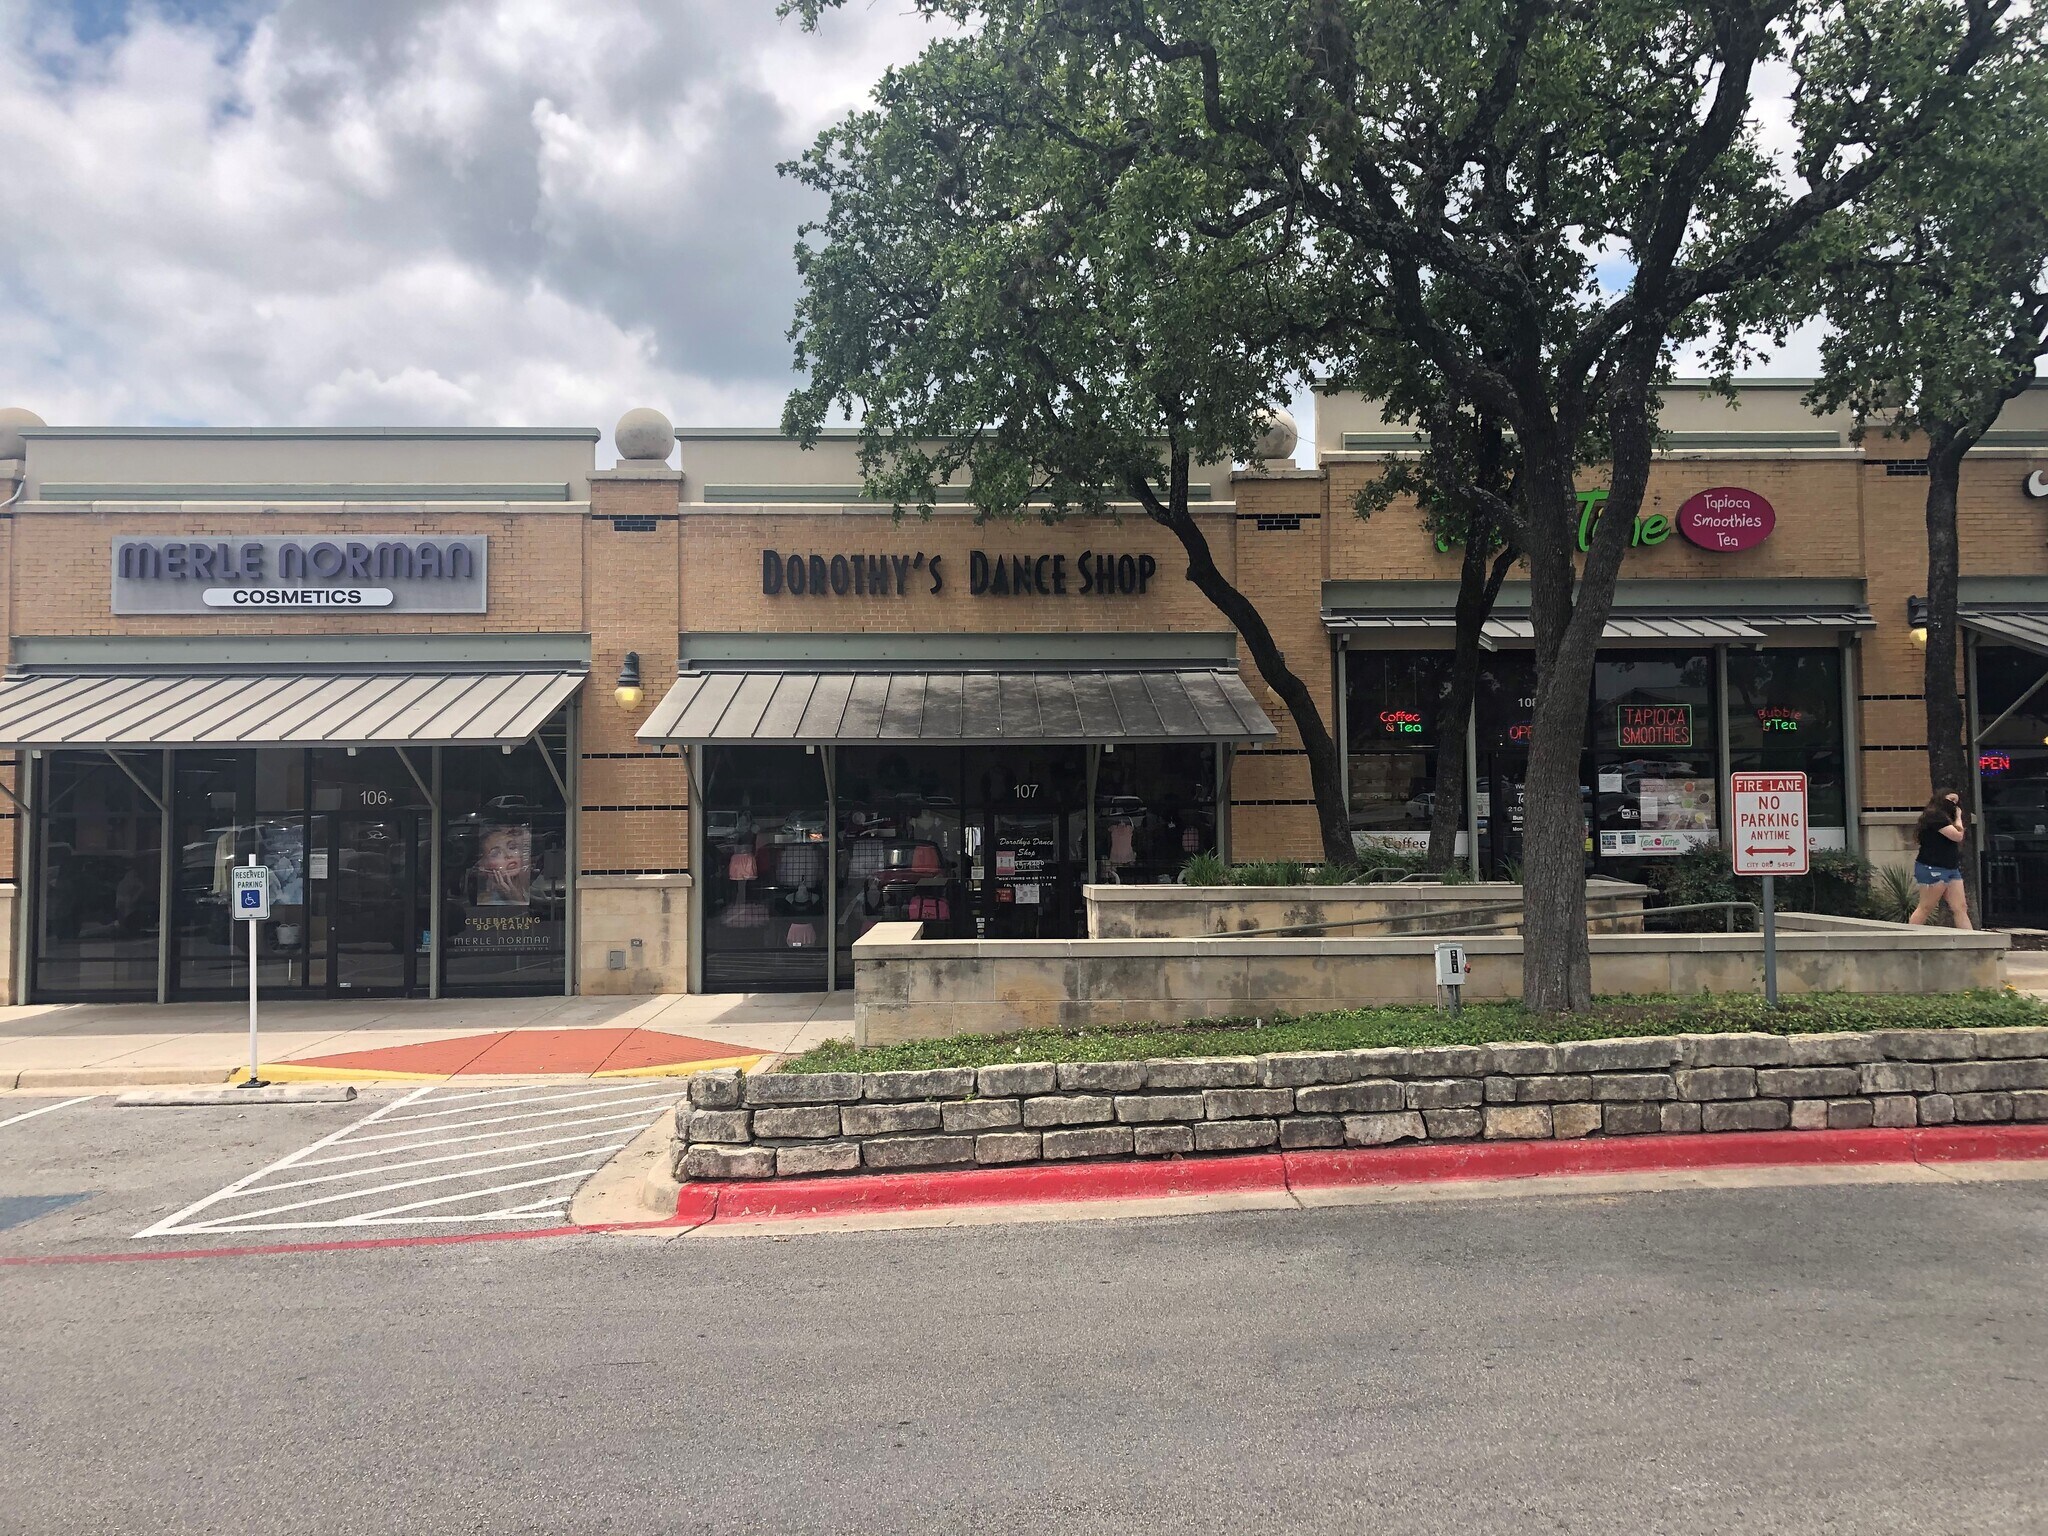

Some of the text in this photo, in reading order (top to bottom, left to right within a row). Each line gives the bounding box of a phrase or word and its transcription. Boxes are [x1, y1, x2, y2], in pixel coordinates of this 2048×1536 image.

[1704, 494, 1750, 512] Tapioca
[1692, 513, 1762, 528] Smoothies
[1716, 532, 1739, 547] Tea
[119, 541, 475, 580] MERLE NORMAN
[232, 589, 362, 604] COSMETICS
[1624, 709, 1686, 725] TAPIOCA
[1397, 721, 1422, 733] Tea
[1771, 718, 1797, 730] Tea
[1622, 727, 1689, 744] SMOOTHIES
[1979, 756, 2010, 769] PEN
[1013, 784, 1039, 798] 107
[1736, 780, 1802, 791] FIRE LANE
[360, 790, 387, 805] 106
[1758, 796, 1780, 810] NO
[1740, 813, 1799, 827] PARKING
[1638, 834, 1681, 846] Tea Time
[1750, 830, 1790, 840] ANYTIME
[1017, 848, 1036, 858] Shop
[235, 871, 265, 879] RESERVED
[464, 917, 541, 925] CELEBRATING
[495, 923, 530, 931] YEARS
[454, 937, 491, 945] MERLE
